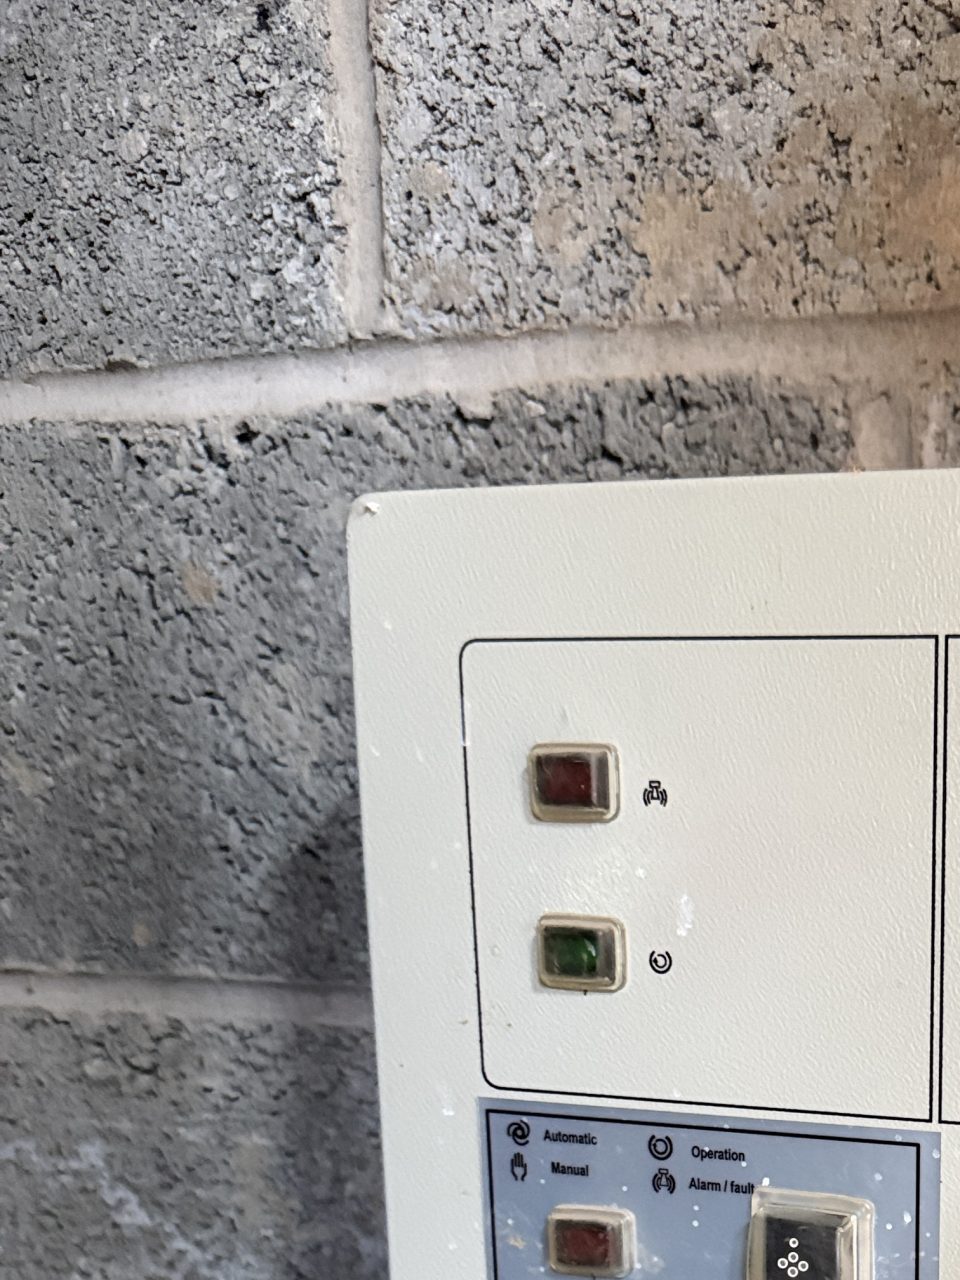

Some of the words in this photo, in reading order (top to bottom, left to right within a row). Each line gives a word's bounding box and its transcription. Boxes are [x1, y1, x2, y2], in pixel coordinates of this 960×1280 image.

[543, 1129, 598, 1146] Automatic
[691, 1145, 746, 1162] Operation
[551, 1161, 589, 1176] Manual
[689, 1177, 721, 1192] Alarm
[730, 1181, 755, 1195] fault
